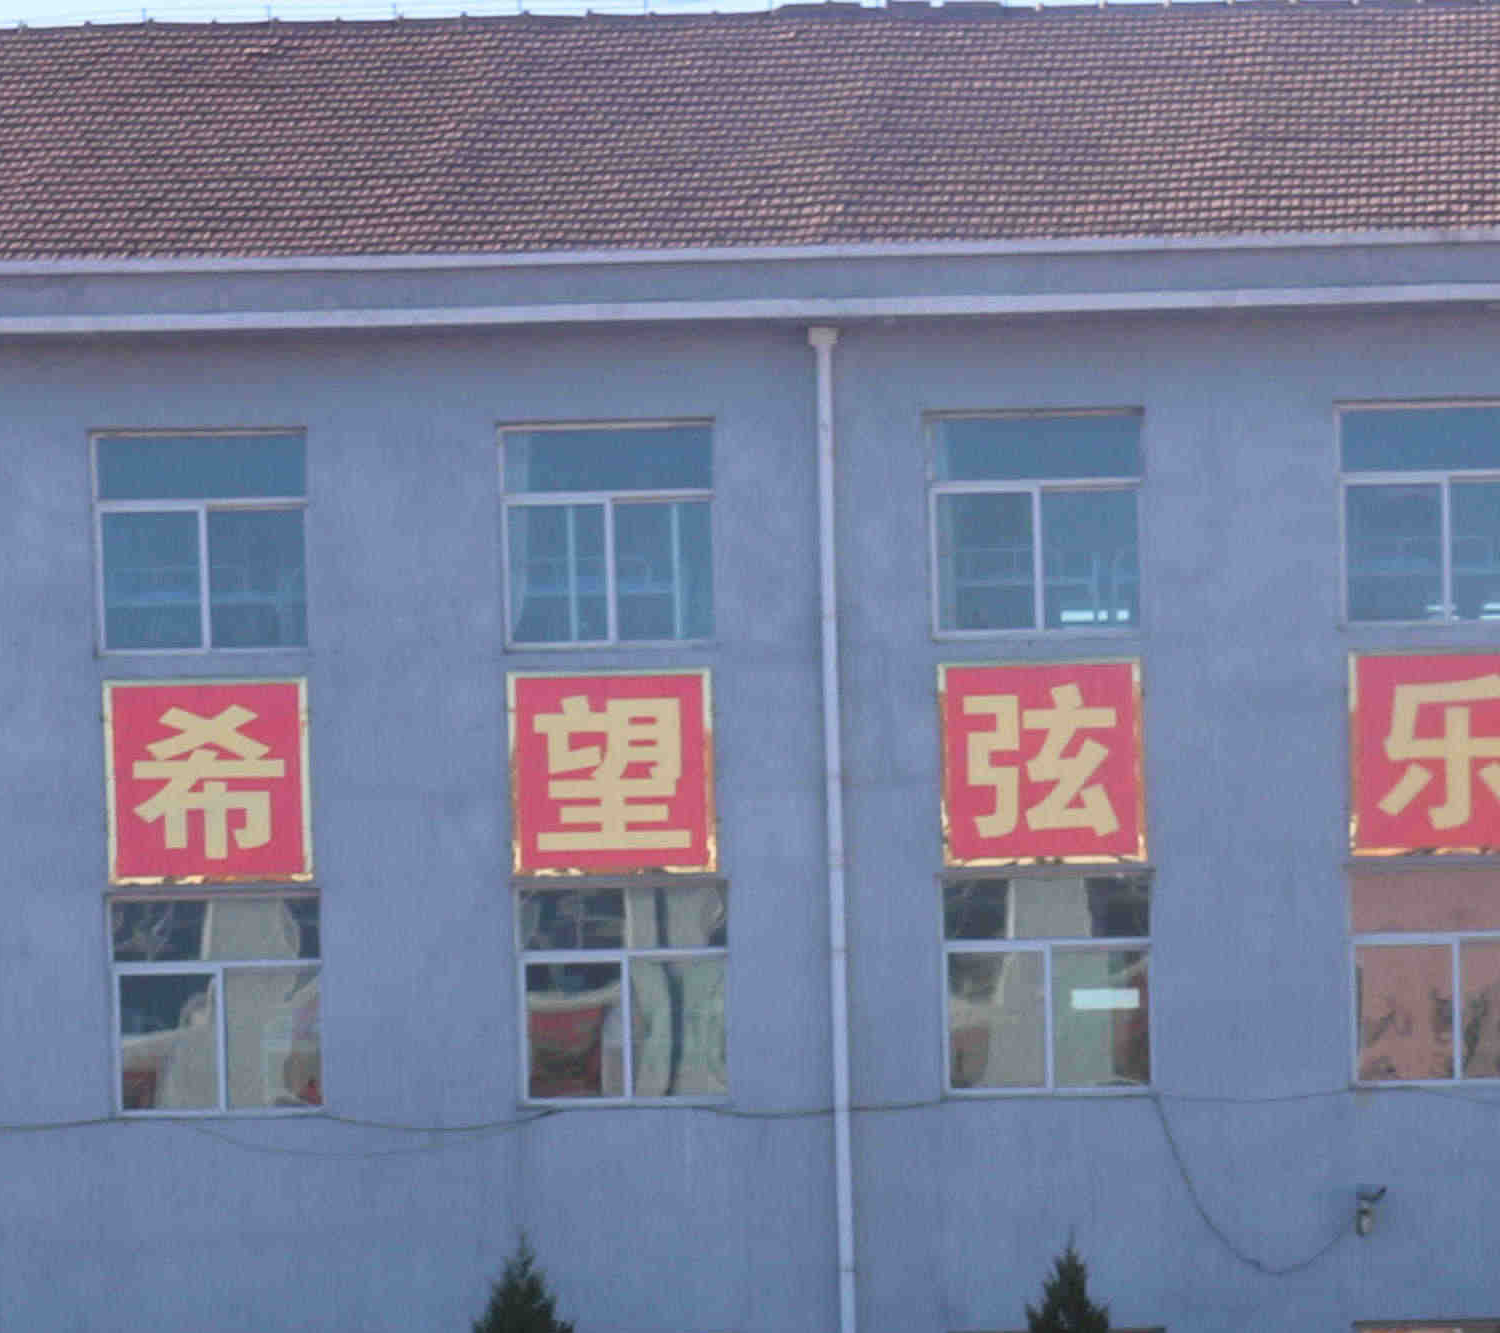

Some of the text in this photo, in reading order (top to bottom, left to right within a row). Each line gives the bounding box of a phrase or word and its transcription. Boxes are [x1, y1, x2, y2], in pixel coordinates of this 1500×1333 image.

[131, 704, 286, 860] 希
[533, 696, 693, 852] 望
[963, 683, 1121, 839] 弦
